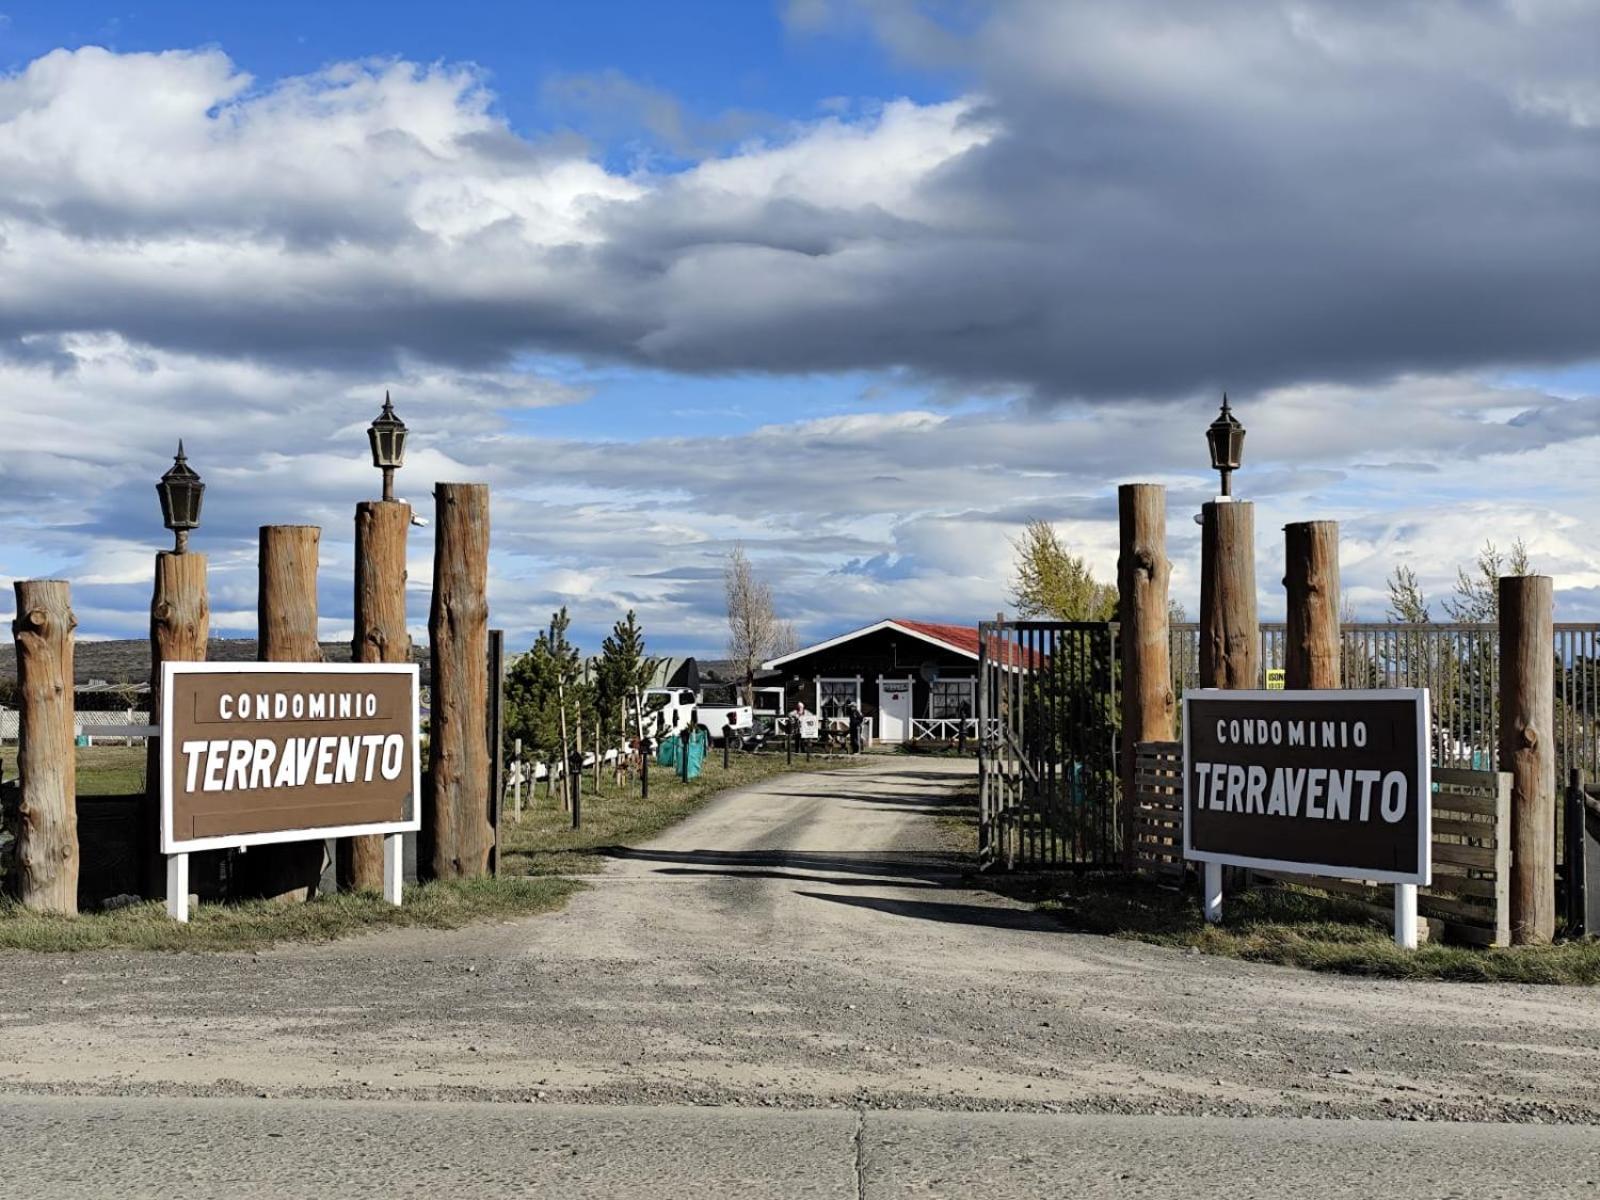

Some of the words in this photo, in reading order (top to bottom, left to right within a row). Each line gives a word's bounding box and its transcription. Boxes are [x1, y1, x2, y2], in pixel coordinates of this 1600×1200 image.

[219, 692, 377, 720] CONDOMINIO
[1216, 719, 1367, 748] CONDOMINIO
[182, 733, 405, 793] TERRAVENTO
[1195, 762, 1408, 824] TERRAVENTO
